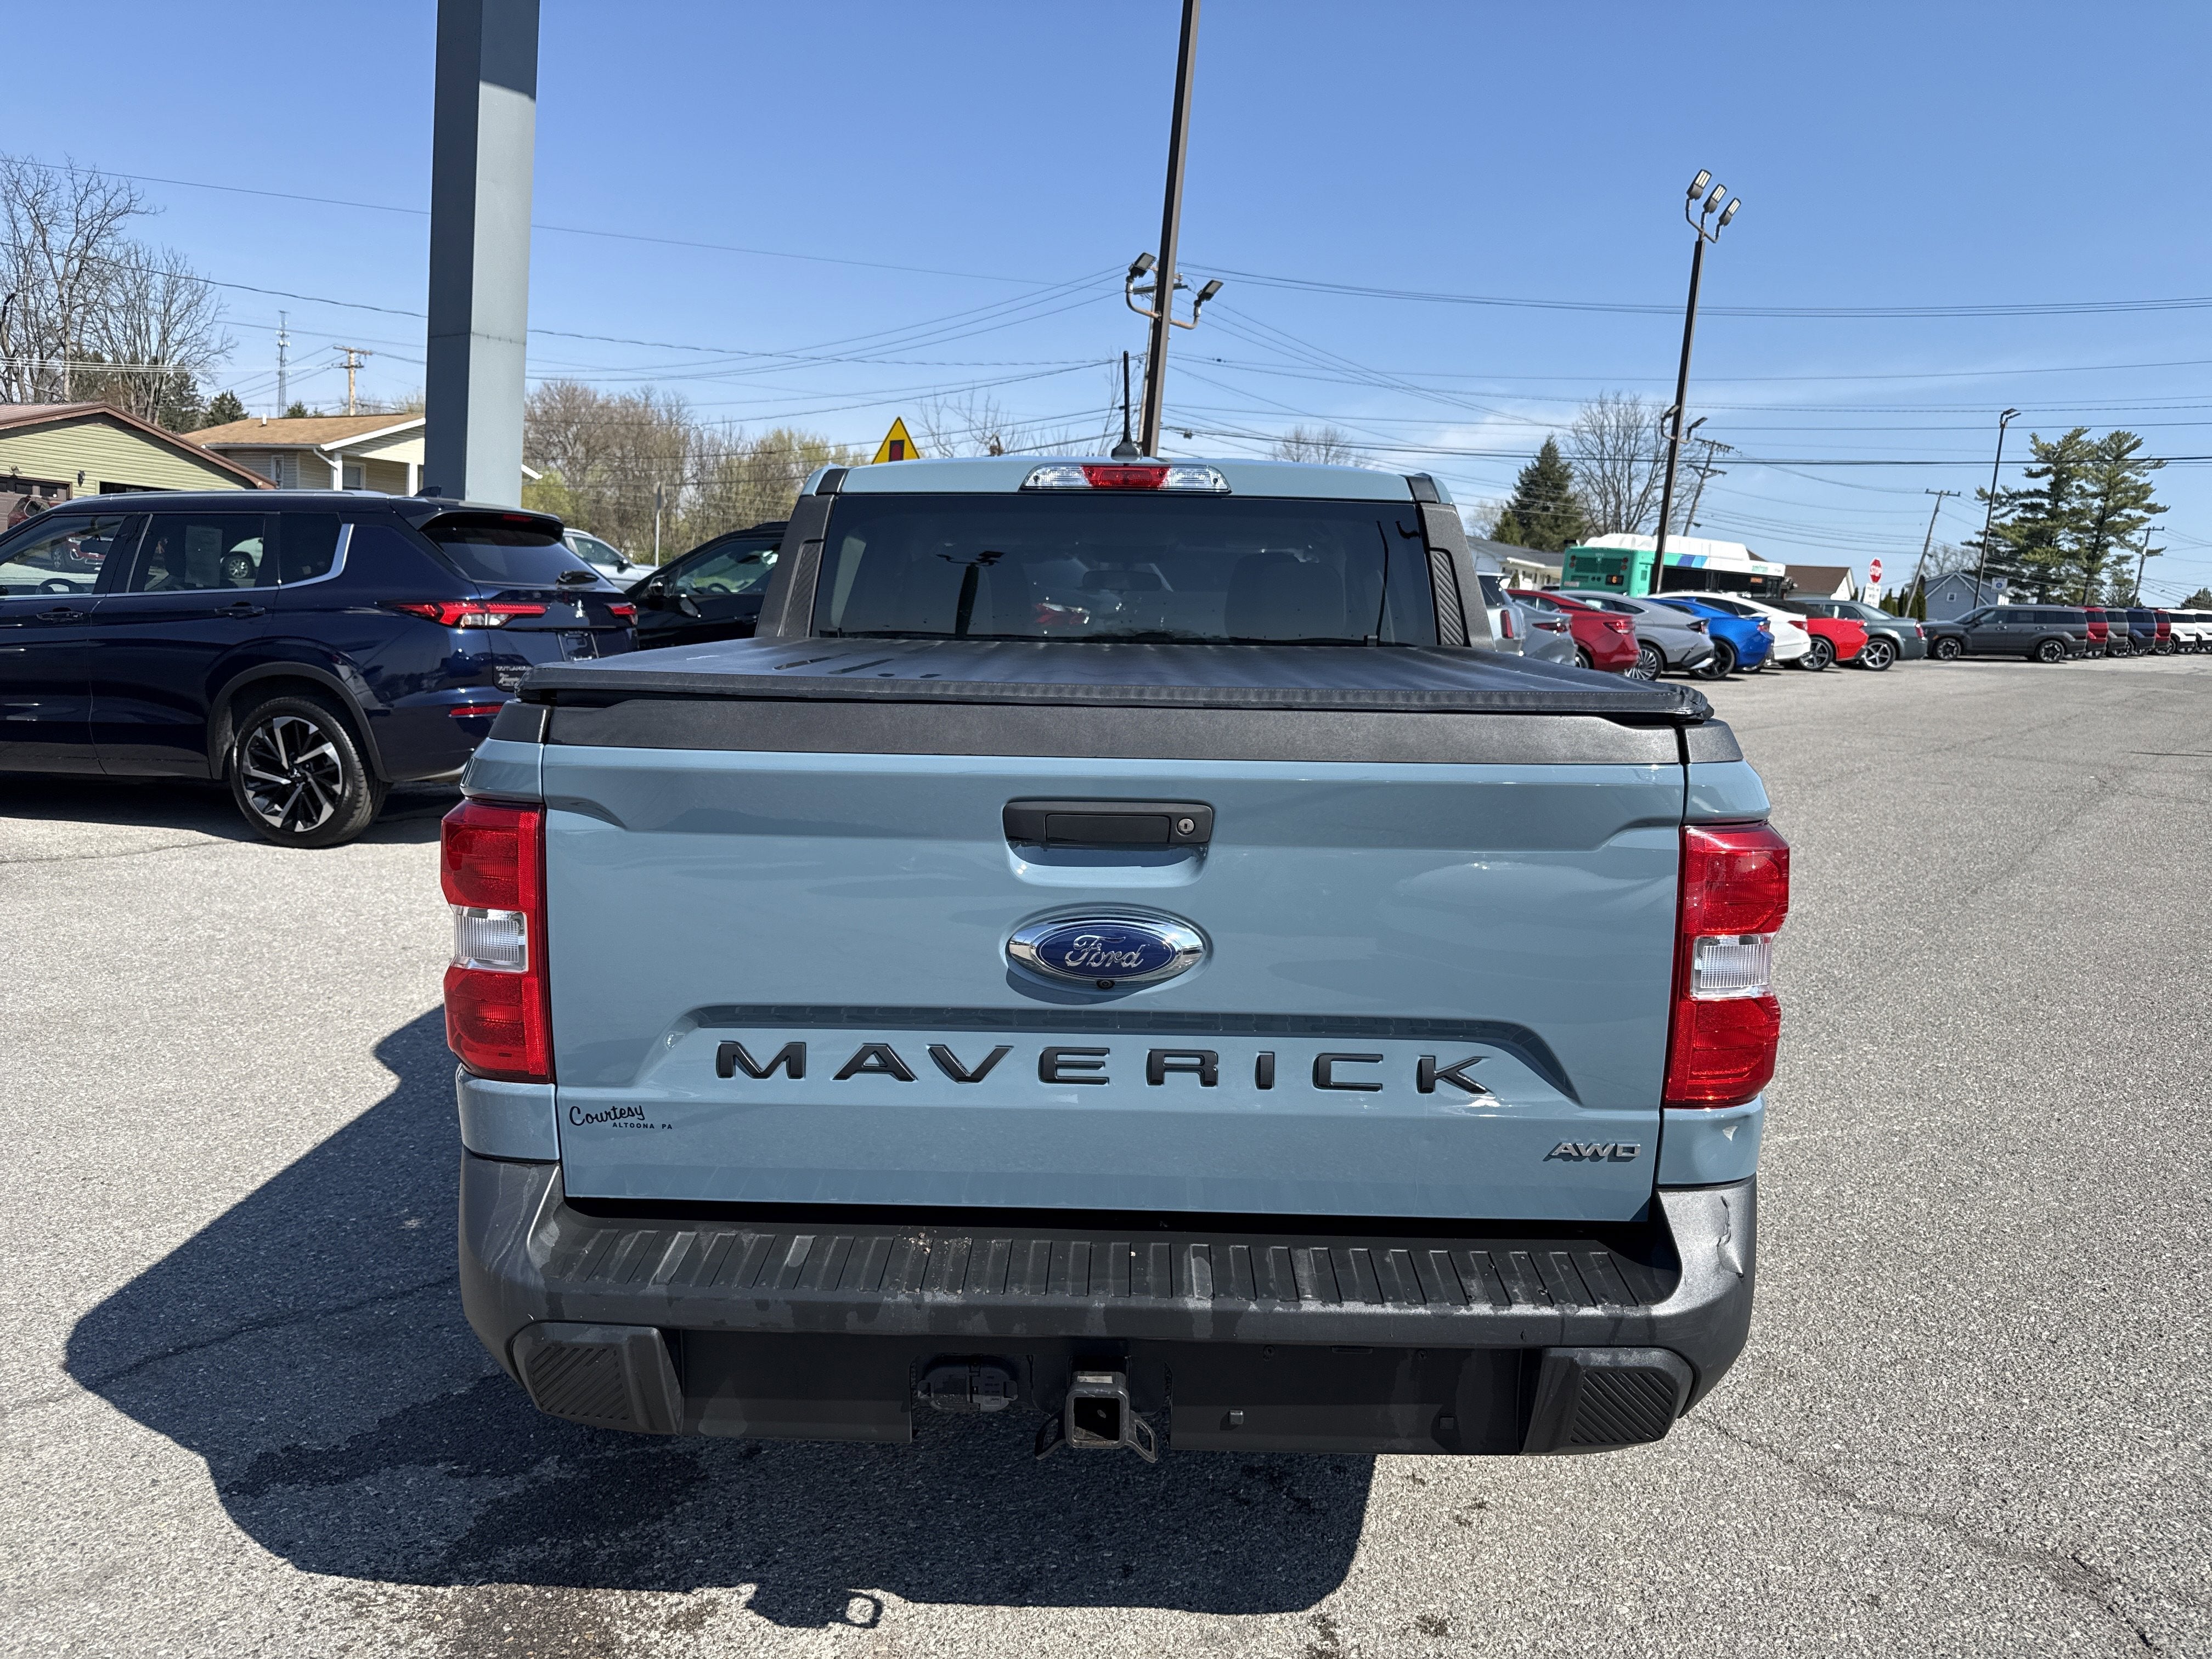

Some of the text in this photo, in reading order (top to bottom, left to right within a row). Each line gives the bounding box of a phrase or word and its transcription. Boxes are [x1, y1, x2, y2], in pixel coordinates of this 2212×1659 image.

[1870, 565, 1882, 577] STOP
[1064, 934, 1144, 968] Ford
[716, 1041, 1491, 1094] MAVERICK
[569, 1105, 646, 1126] Courtesy
[1550, 1142, 1640, 1157] AWD
